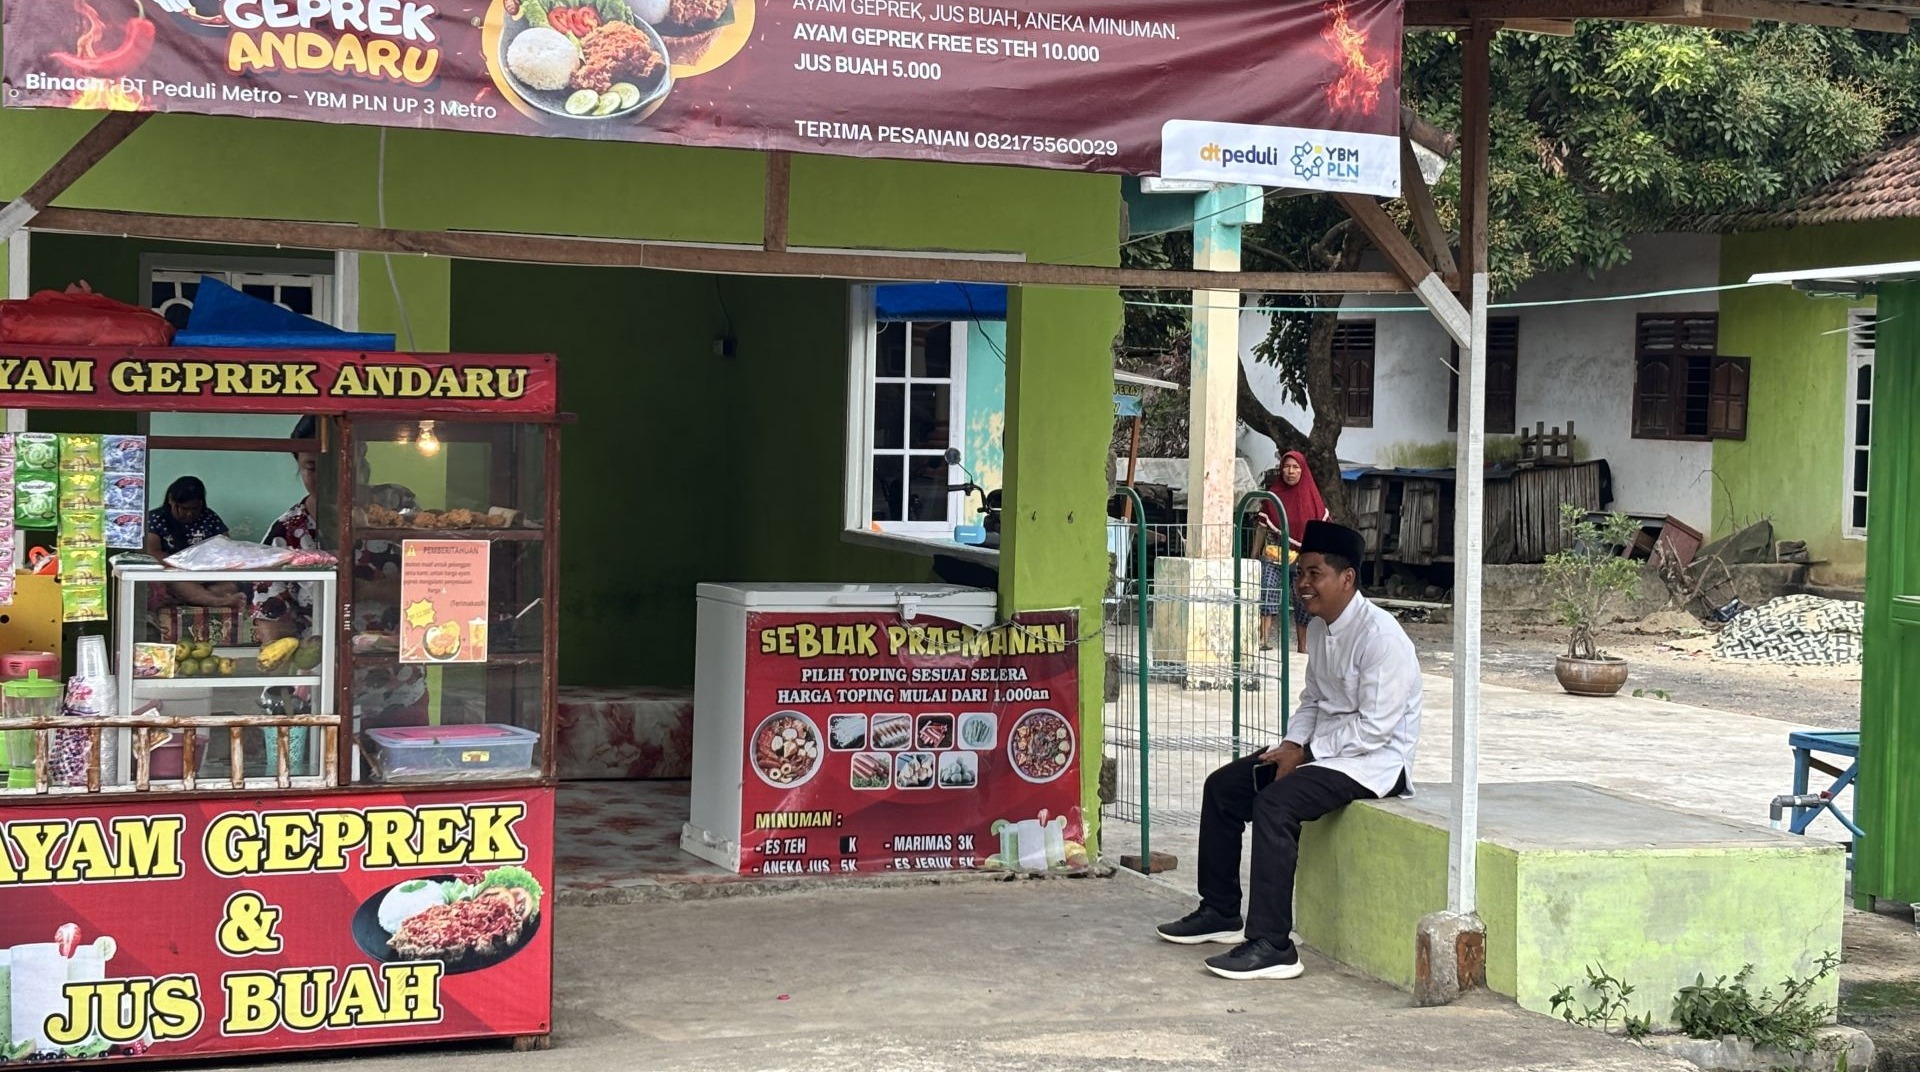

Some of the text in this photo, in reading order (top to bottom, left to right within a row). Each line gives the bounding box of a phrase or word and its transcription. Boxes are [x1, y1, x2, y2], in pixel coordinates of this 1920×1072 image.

[223, 0, 436, 43] GEPREK
[793, 0, 1181, 41] AYAM GEPREK, JUS BUAH, ANEKA MINUMAN.
[228, 31, 439, 83] ANDARU
[793, 22, 1100, 63] AYAM GEPREK FREE ES TEH 10.000
[794, 53, 942, 81] JUS BUAH 5.000
[120, 78, 146, 94] DT
[152, 80, 216, 100] Peduli
[222, 85, 282, 104] Metro
[304, 90, 346, 109] YBM
[352, 94, 387, 112] PLN
[393, 97, 419, 114] UP
[423, 100, 435, 115] 3
[440, 101, 497, 119] Metro
[795, 119, 1118, 156] TERIMA PESANAN 082175560029
[1325, 147, 1359, 163] YBM
[1327, 162, 1359, 178] PLN
[110, 361, 319, 395] GEPREK
[329, 365, 528, 399] ANDARU
[761, 622, 1066, 658] SEBLAK PRASMANAN
[801, 667, 1028, 683] PILIH TOPING SESUAI SELERA
[777, 687, 1050, 703] HARGA TOPING MULAI DARI 1.000an
[206, 804, 524, 873] GEPREK
[755, 811, 832, 830] MINUMAN
[765, 839, 781, 855] ES
[784, 838, 806, 854] TEH
[893, 835, 952, 852] MARIMAS
[957, 834, 974, 851] 3K
[763, 860, 804, 875] ANEKA
[807, 858, 831, 873] JUS
[840, 858, 858, 873] 5K
[894, 857, 911, 870] ES
[914, 856, 954, 870] JERUK
[958, 856, 975, 869] 5K
[219, 892, 279, 953] &
[46, 965, 441, 1043] JUS BUAH
